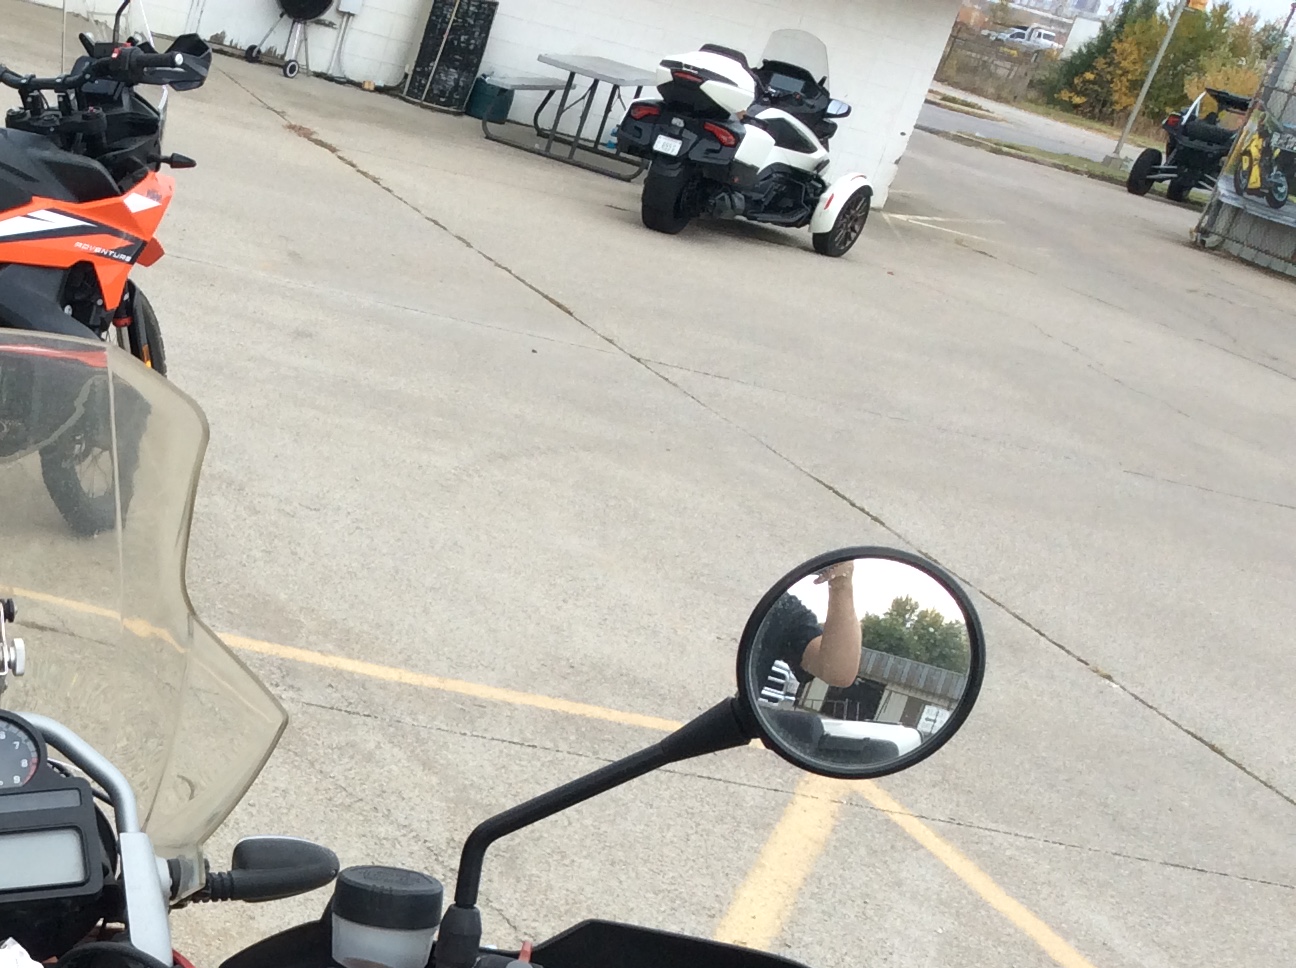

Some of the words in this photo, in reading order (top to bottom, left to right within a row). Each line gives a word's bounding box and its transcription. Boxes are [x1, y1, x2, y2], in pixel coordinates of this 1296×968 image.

[13, 741, 20, 750] 7
[21, 759, 28, 768] 8
[13, 775, 21, 784] 9
